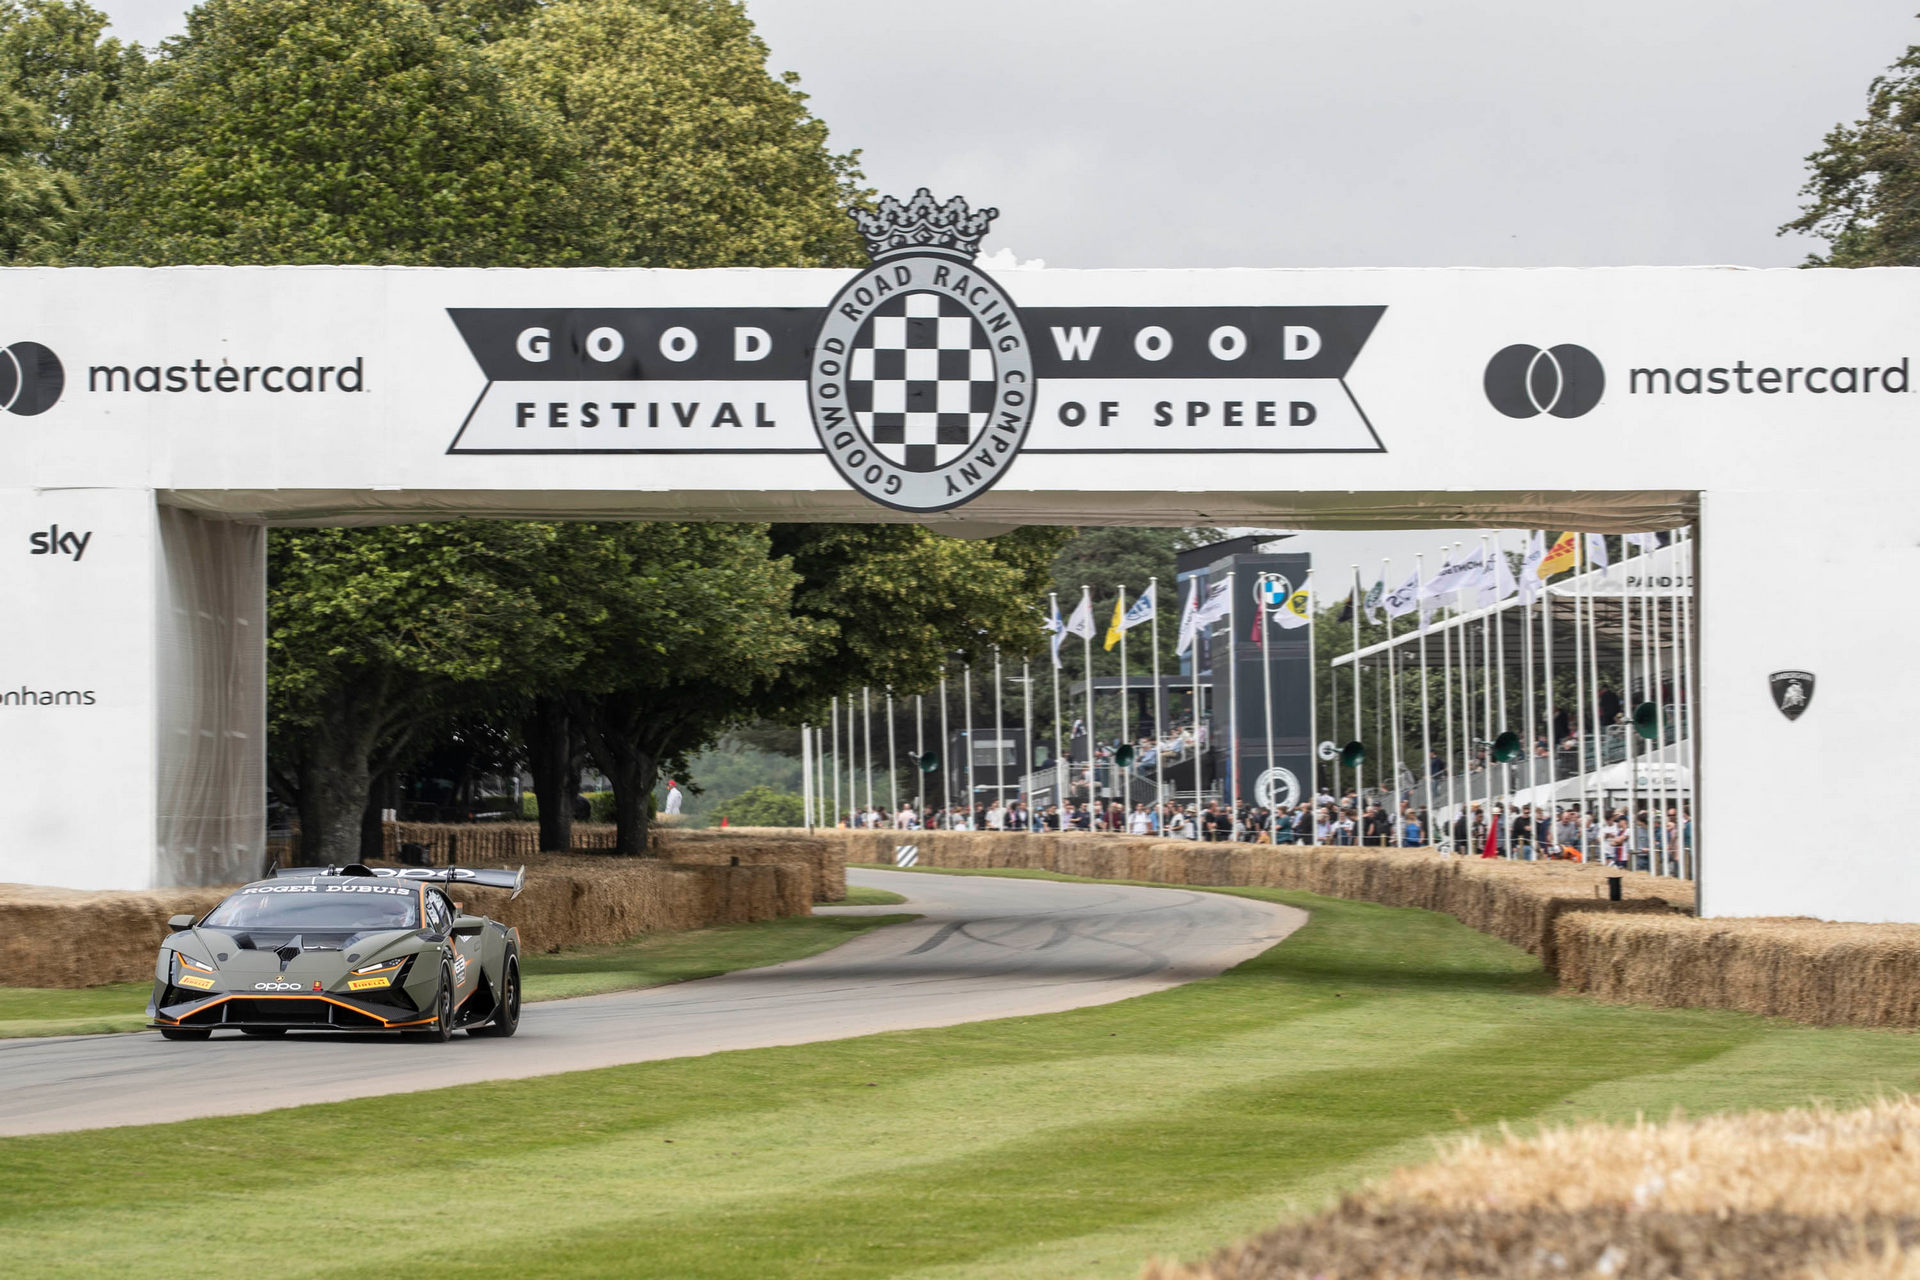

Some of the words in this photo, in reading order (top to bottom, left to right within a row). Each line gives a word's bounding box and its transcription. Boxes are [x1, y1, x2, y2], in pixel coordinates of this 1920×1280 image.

[840, 264, 912, 322] ROAD
[933, 264, 1021, 353] RACING
[515, 326, 773, 363] GOOD
[1050, 325, 1323, 362] WOOD
[89, 356, 364, 393] mastercard
[1630, 356, 1910, 394] mastercard
[515, 401, 777, 428] FESTIVAL
[1058, 400, 1120, 428] OF
[1153, 400, 1318, 428] SPEED
[818, 336, 903, 496] GOODWOOD
[944, 369, 1025, 497] COMPANY
[30, 524, 92, 562] sky
[0, 685, 96, 706] nhams
[241, 885, 318, 895] ROGER
[325, 884, 411, 896] DUBUIS
[254, 982, 302, 991] oppo
[352, 979, 386, 988] PIRELLI
